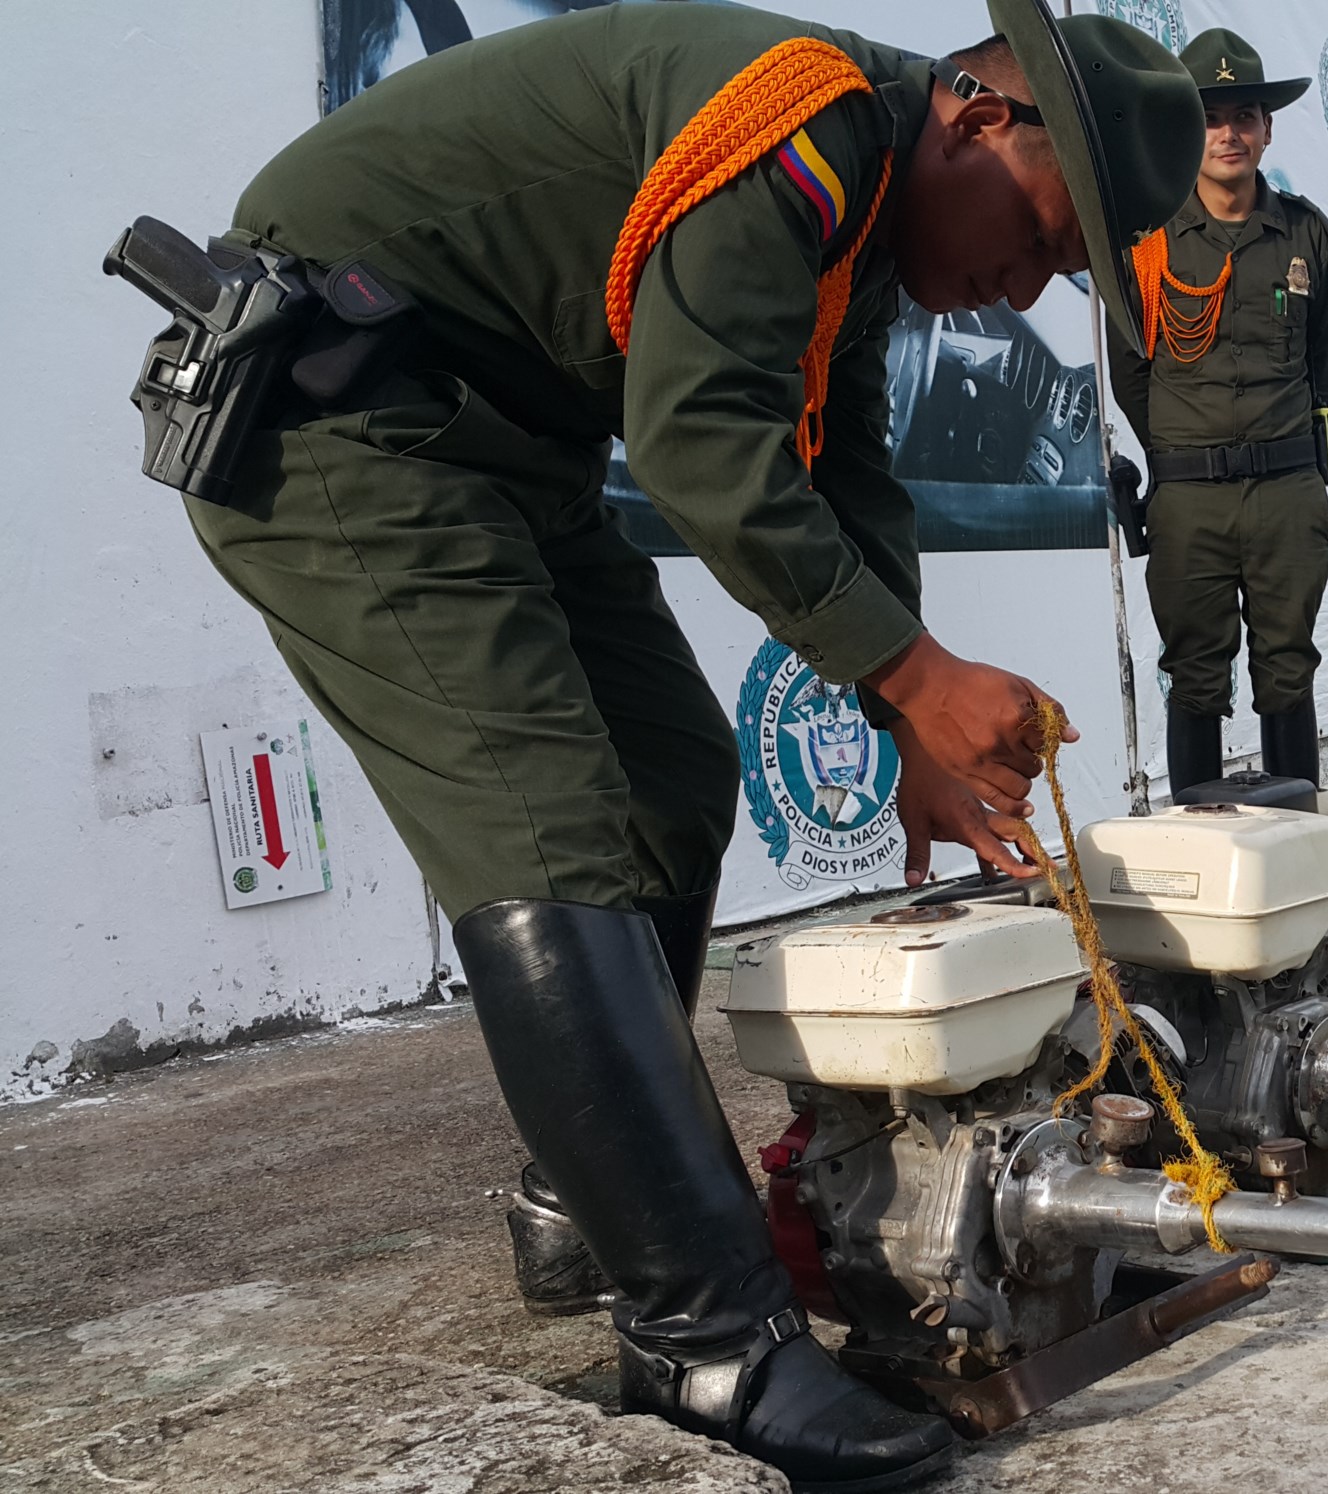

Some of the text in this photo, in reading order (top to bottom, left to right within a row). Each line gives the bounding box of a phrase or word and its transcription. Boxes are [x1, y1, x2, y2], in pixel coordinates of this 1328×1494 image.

[762, 654, 808, 769] REPÚBLICA
[245, 767, 263, 846] RUTA SANITARIA
[778, 777, 900, 848] POLICÍA NACION
[852, 836, 899, 873] PATRIA
